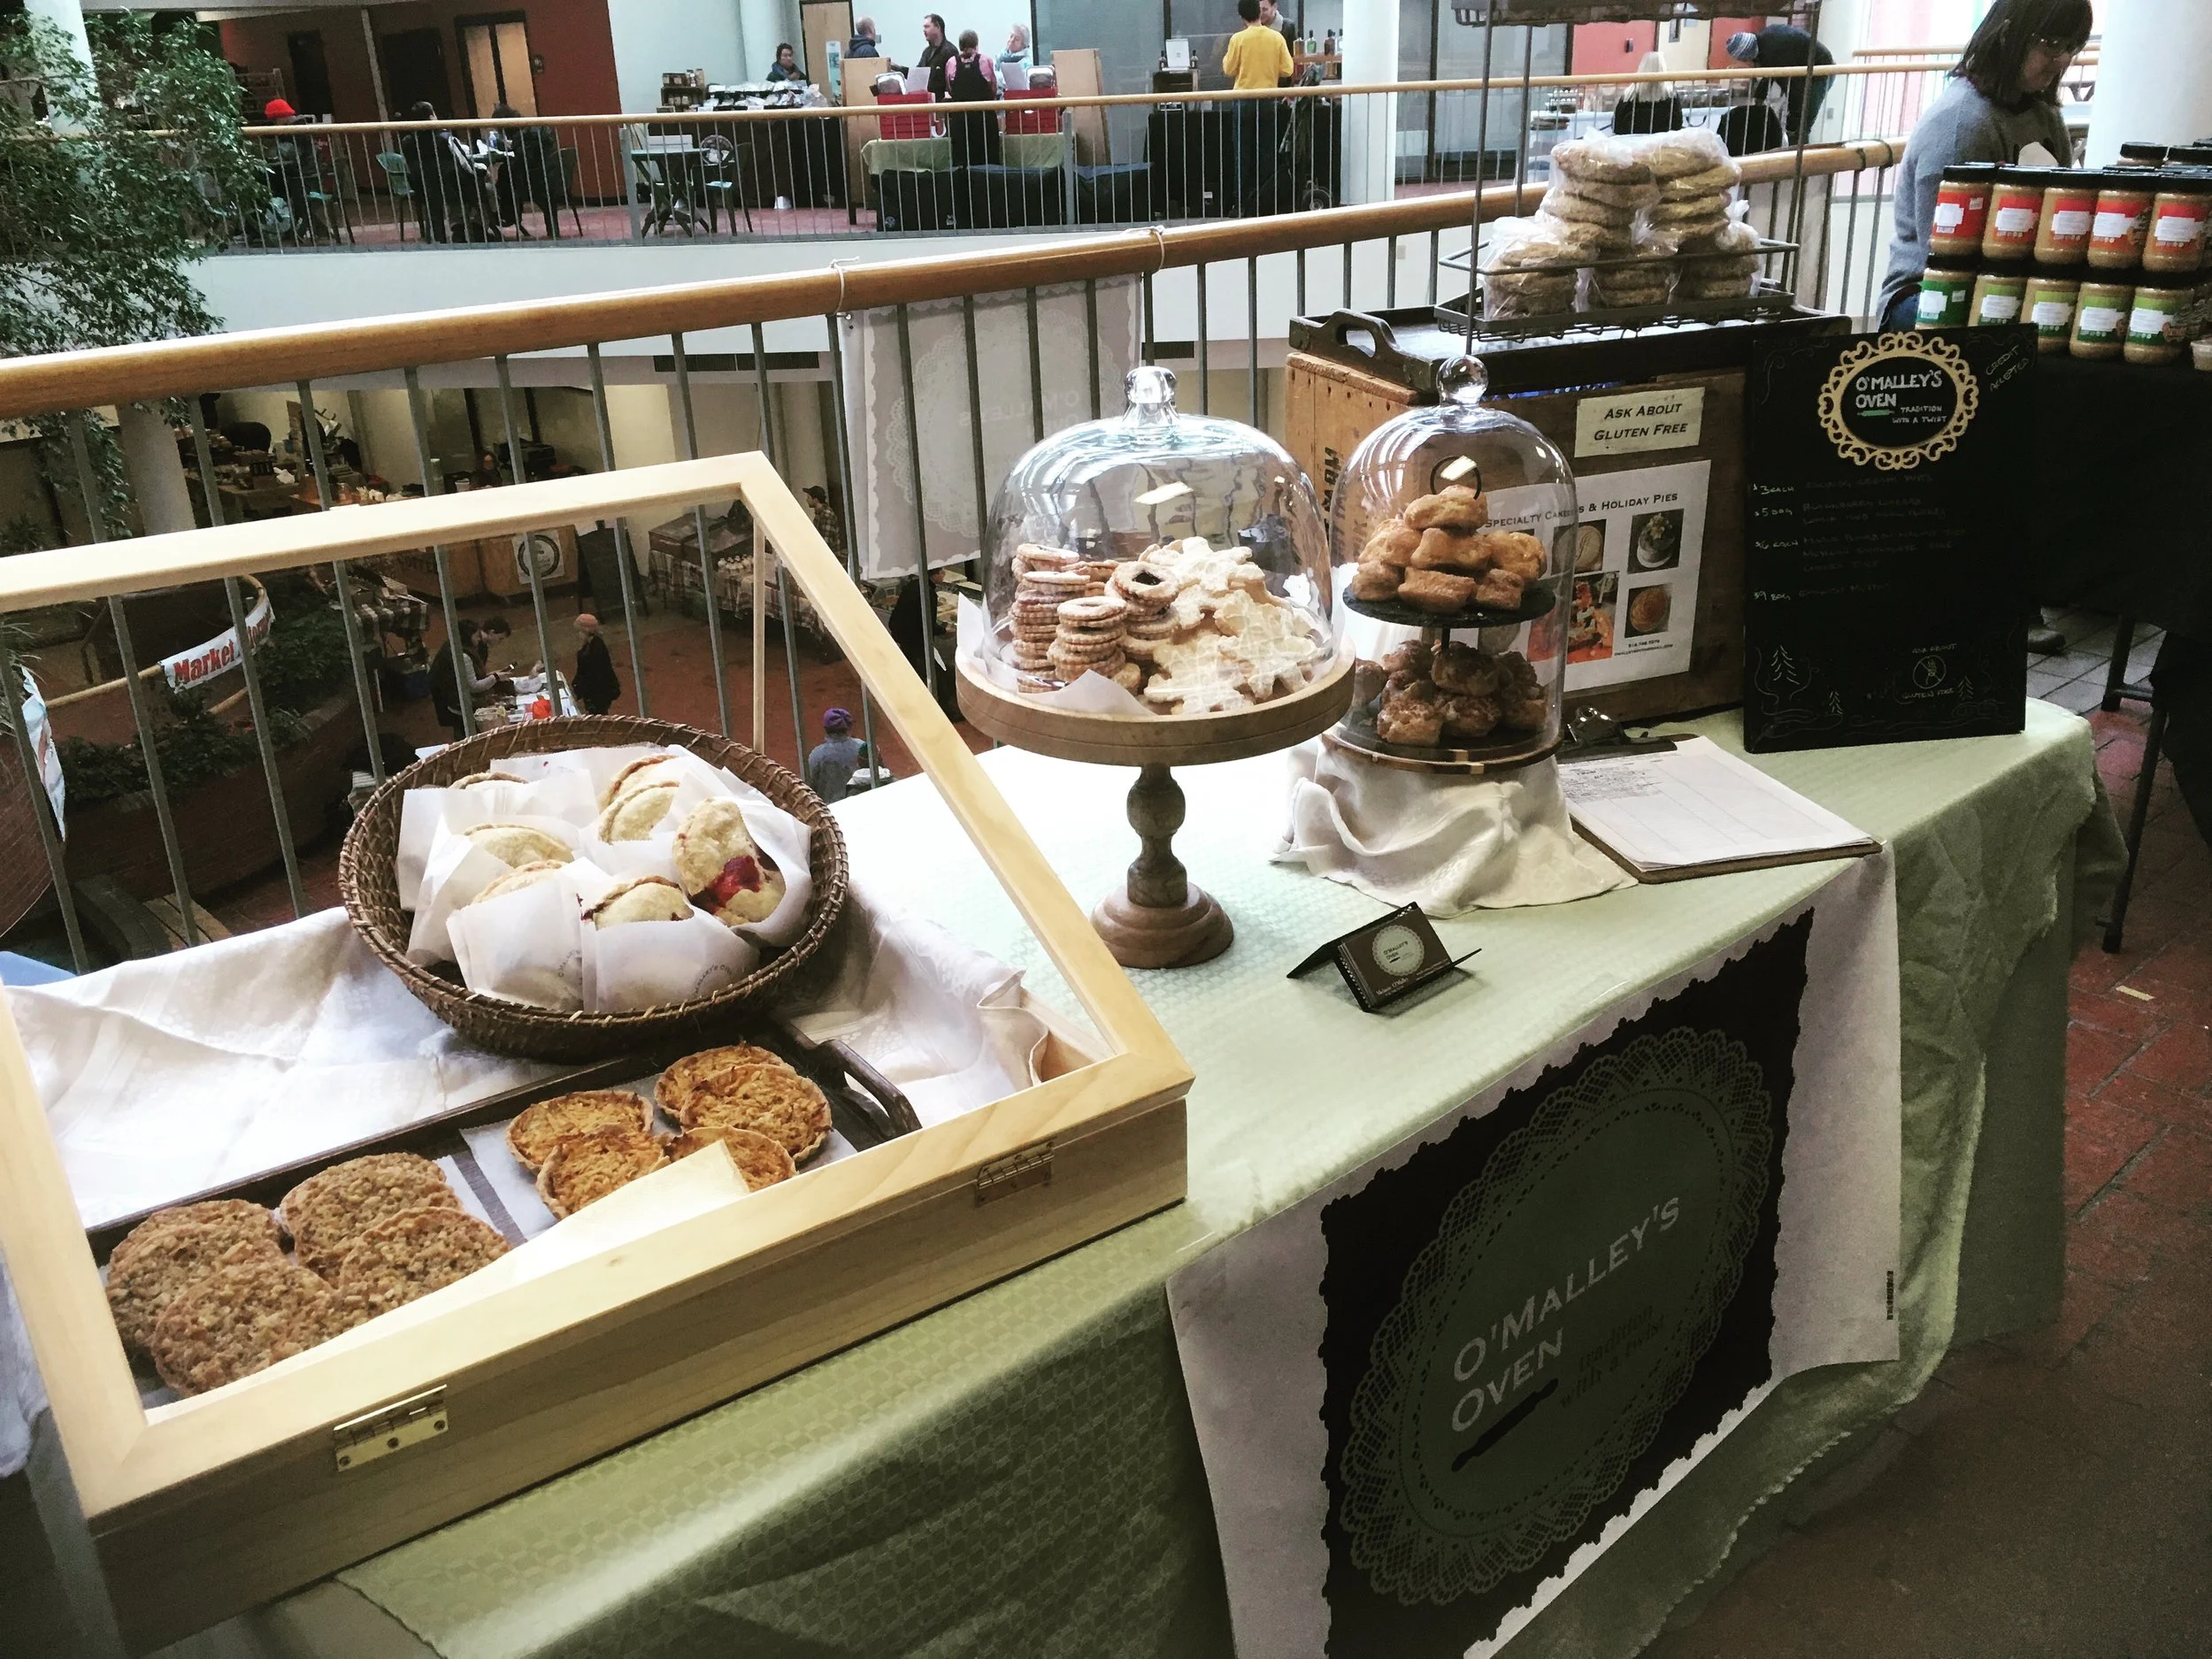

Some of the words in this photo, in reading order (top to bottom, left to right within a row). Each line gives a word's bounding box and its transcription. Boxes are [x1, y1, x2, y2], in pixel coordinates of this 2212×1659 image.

[1855, 369, 1943, 393] O'MALLEY'S
[1603, 408, 1633, 420] ASK
[1636, 403, 1683, 417] ABOUT
[1855, 392, 1897, 410] OVEN
[1900, 405, 1943, 414] TRADITION
[1594, 426, 1650, 442] GLUTEN
[1653, 422, 1689, 435] FREE
[1892, 415, 1910, 425] WITH
[1912, 415, 1919, 425] A
[1921, 415, 1947, 424] TWIST
[1485, 511, 1542, 528] SPECIALTY
[1588, 503, 1597, 511] &
[1601, 496, 1650, 511] HOLIDAY
[1652, 492, 1678, 504] PIES
[173, 639, 235, 687] Market
[1453, 1195, 1681, 1383] O'MALLEY'S
[1578, 1304, 1655, 1372] tradition
[1559, 1364, 1604, 1409] with
[1609, 1355, 1620, 1371] a
[1625, 1313, 1666, 1357] twist
[1451, 1327, 1564, 1432] OVEN
